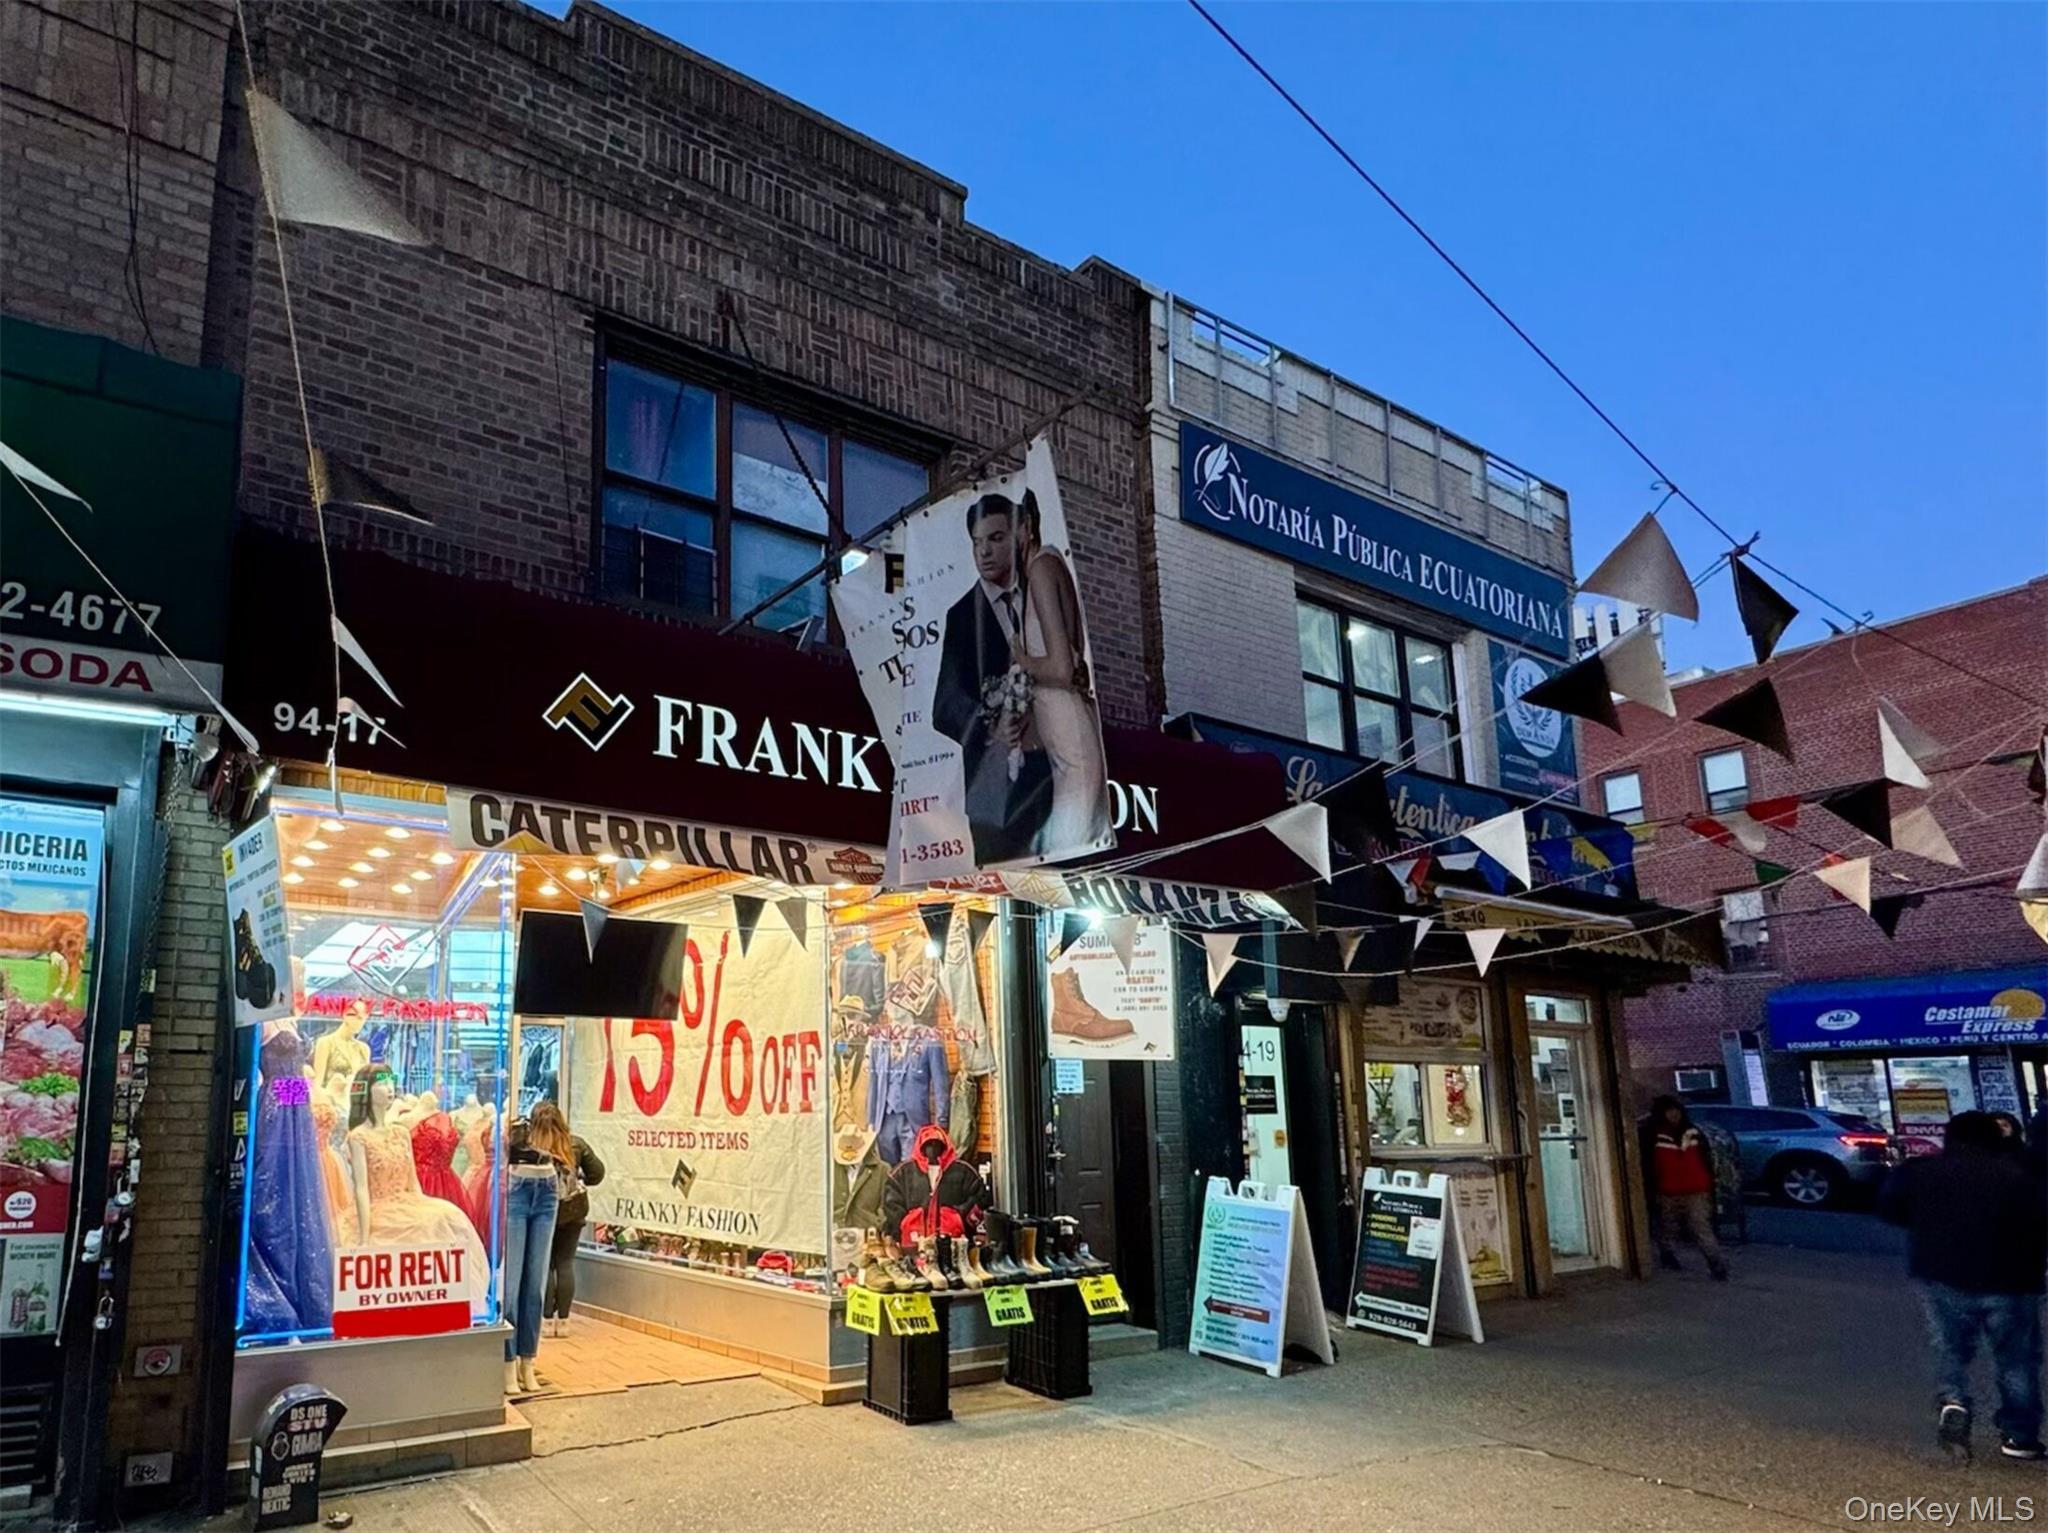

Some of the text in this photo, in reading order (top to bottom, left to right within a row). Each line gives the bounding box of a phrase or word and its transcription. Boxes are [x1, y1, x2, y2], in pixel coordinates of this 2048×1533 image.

[1228, 473, 1563, 639] NOTARÍA PÚBLICA ECUATORIANA
[653, 693, 893, 794] FRANK
[1389, 785, 1477, 836] tentica
[470, 793, 815, 885] CATERPILLAR
[27, 861, 87, 877] MEXICANOS
[1925, 1005, 2012, 1023] Costamar
[1961, 1019, 2037, 1034] Express
[760, 1030, 822, 1116] OFF
[627, 1129, 750, 1151] SELECTED ITEMS
[616, 1198, 761, 1236] FRANKY FASHION
[339, 1249, 465, 1292] FOR RENT
[359, 1289, 447, 1306] BY OWNER
[995, 1306, 1026, 1321] GRATIS
